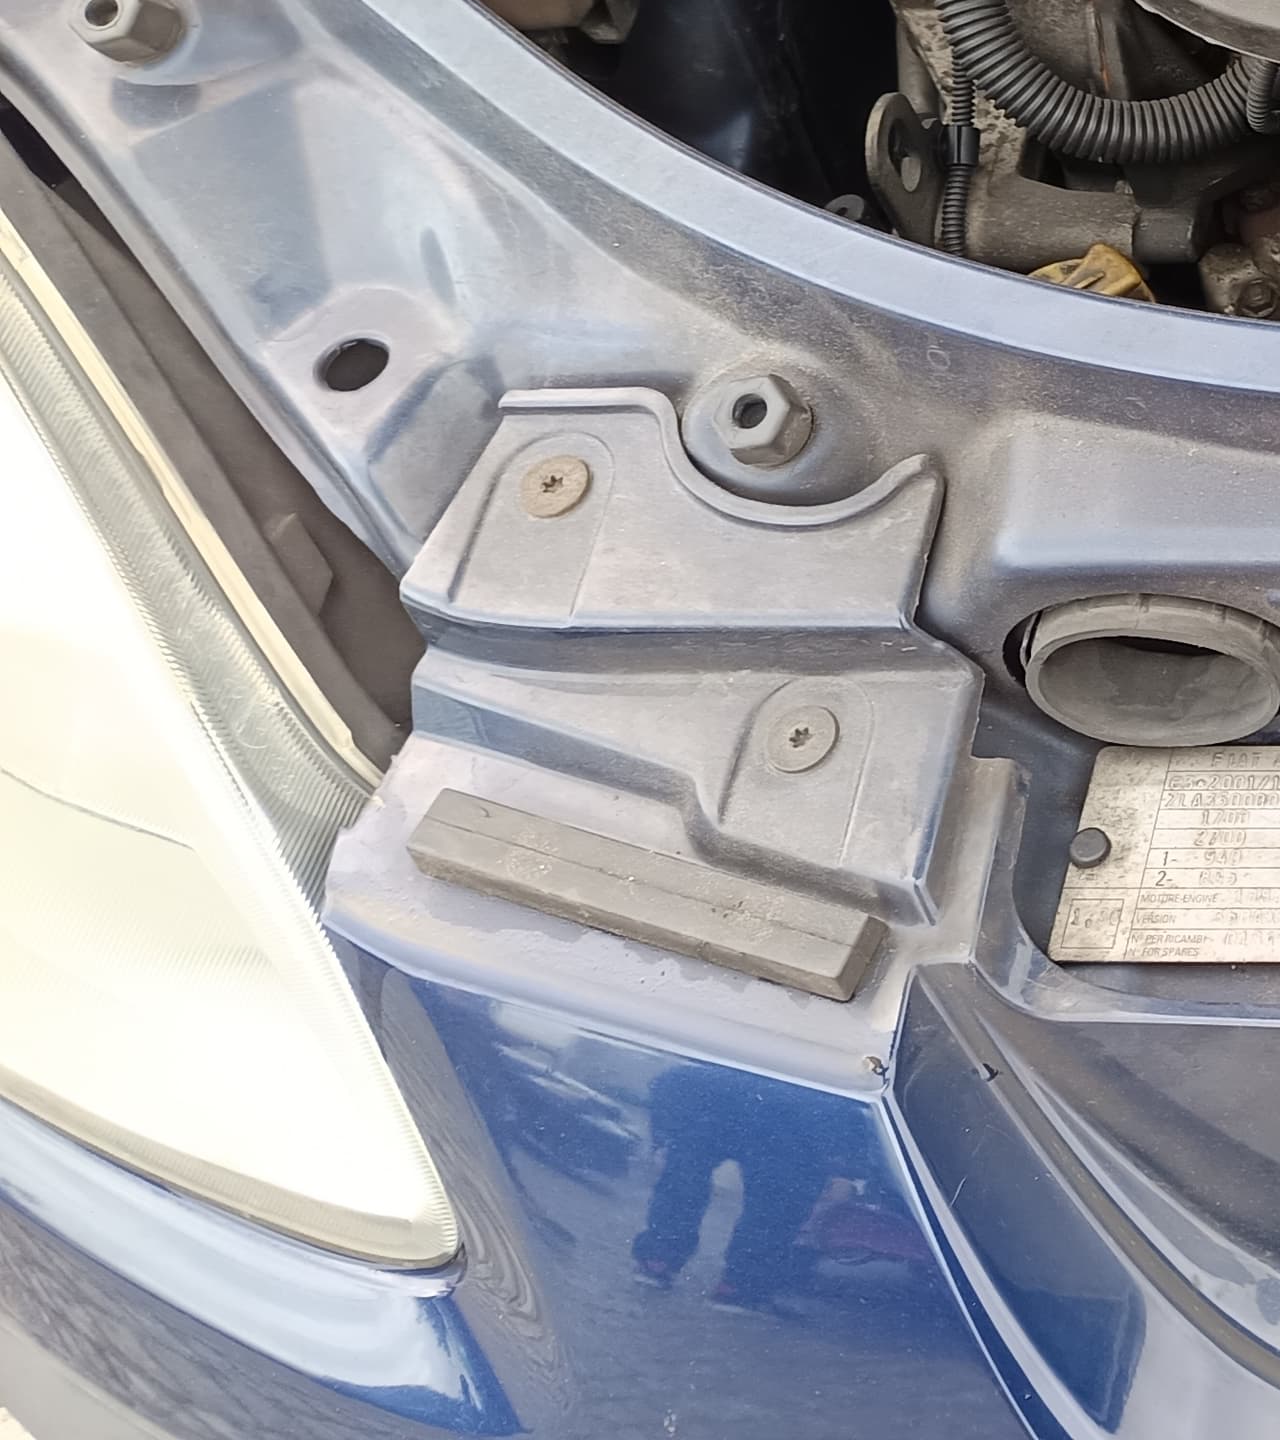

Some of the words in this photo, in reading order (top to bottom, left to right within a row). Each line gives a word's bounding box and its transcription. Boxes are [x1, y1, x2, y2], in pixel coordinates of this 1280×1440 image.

[1211, 751, 1270, 769] FIAT
[1144, 934, 1163, 946] PER
[1142, 946, 1162, 958] FOR
[1163, 946, 1200, 958] SPARES
